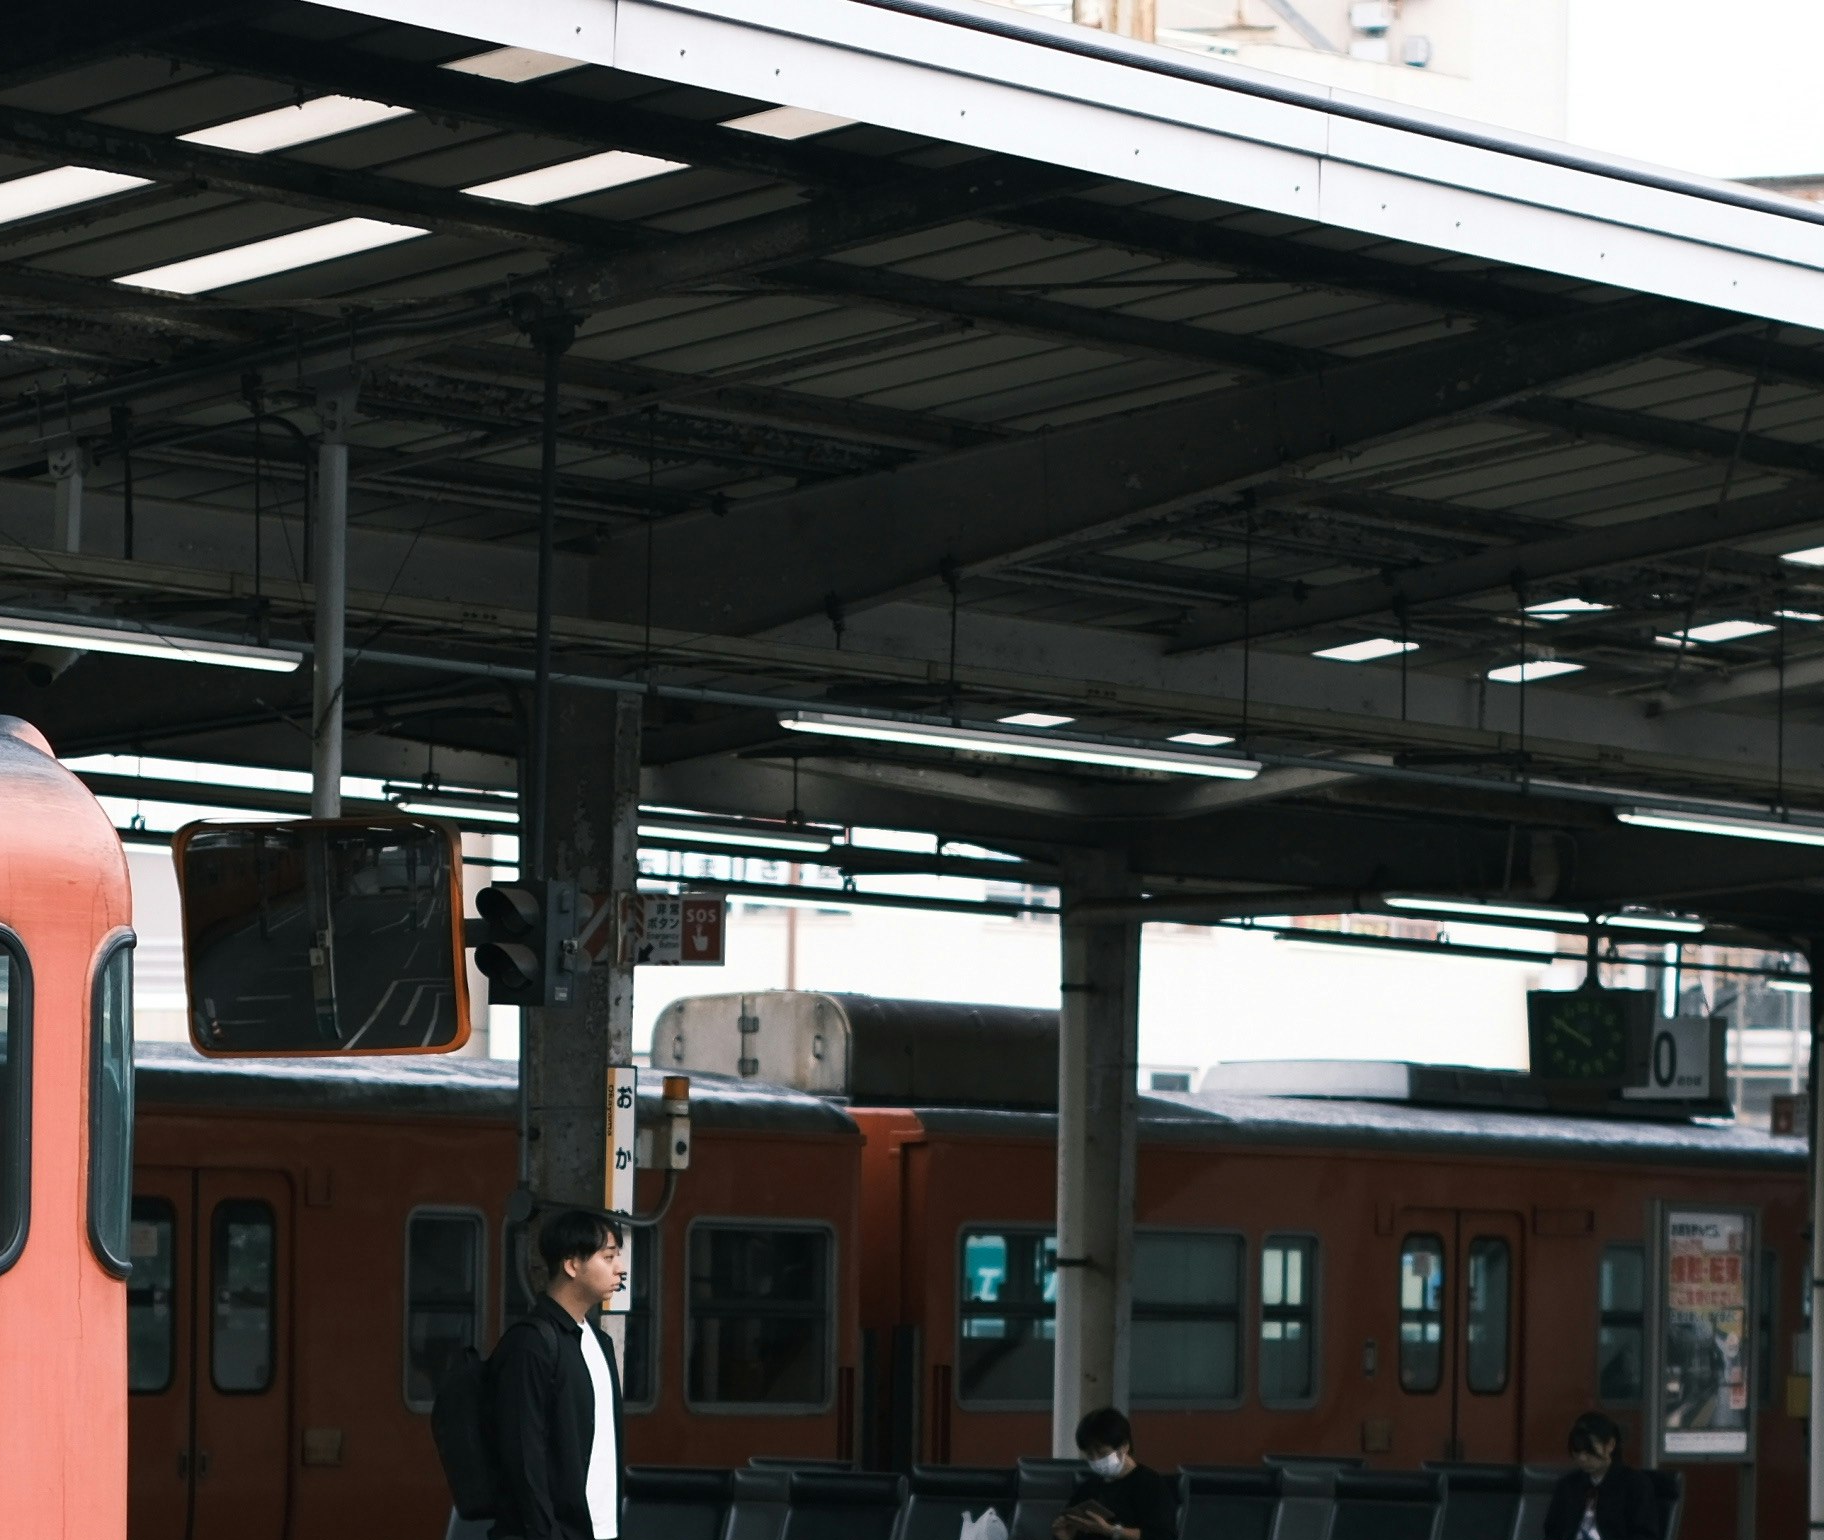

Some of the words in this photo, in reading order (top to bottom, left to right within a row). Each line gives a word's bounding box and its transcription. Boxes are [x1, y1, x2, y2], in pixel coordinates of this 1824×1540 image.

[686, 908, 717, 923] SOS
[647, 917, 680, 931] ボタン
